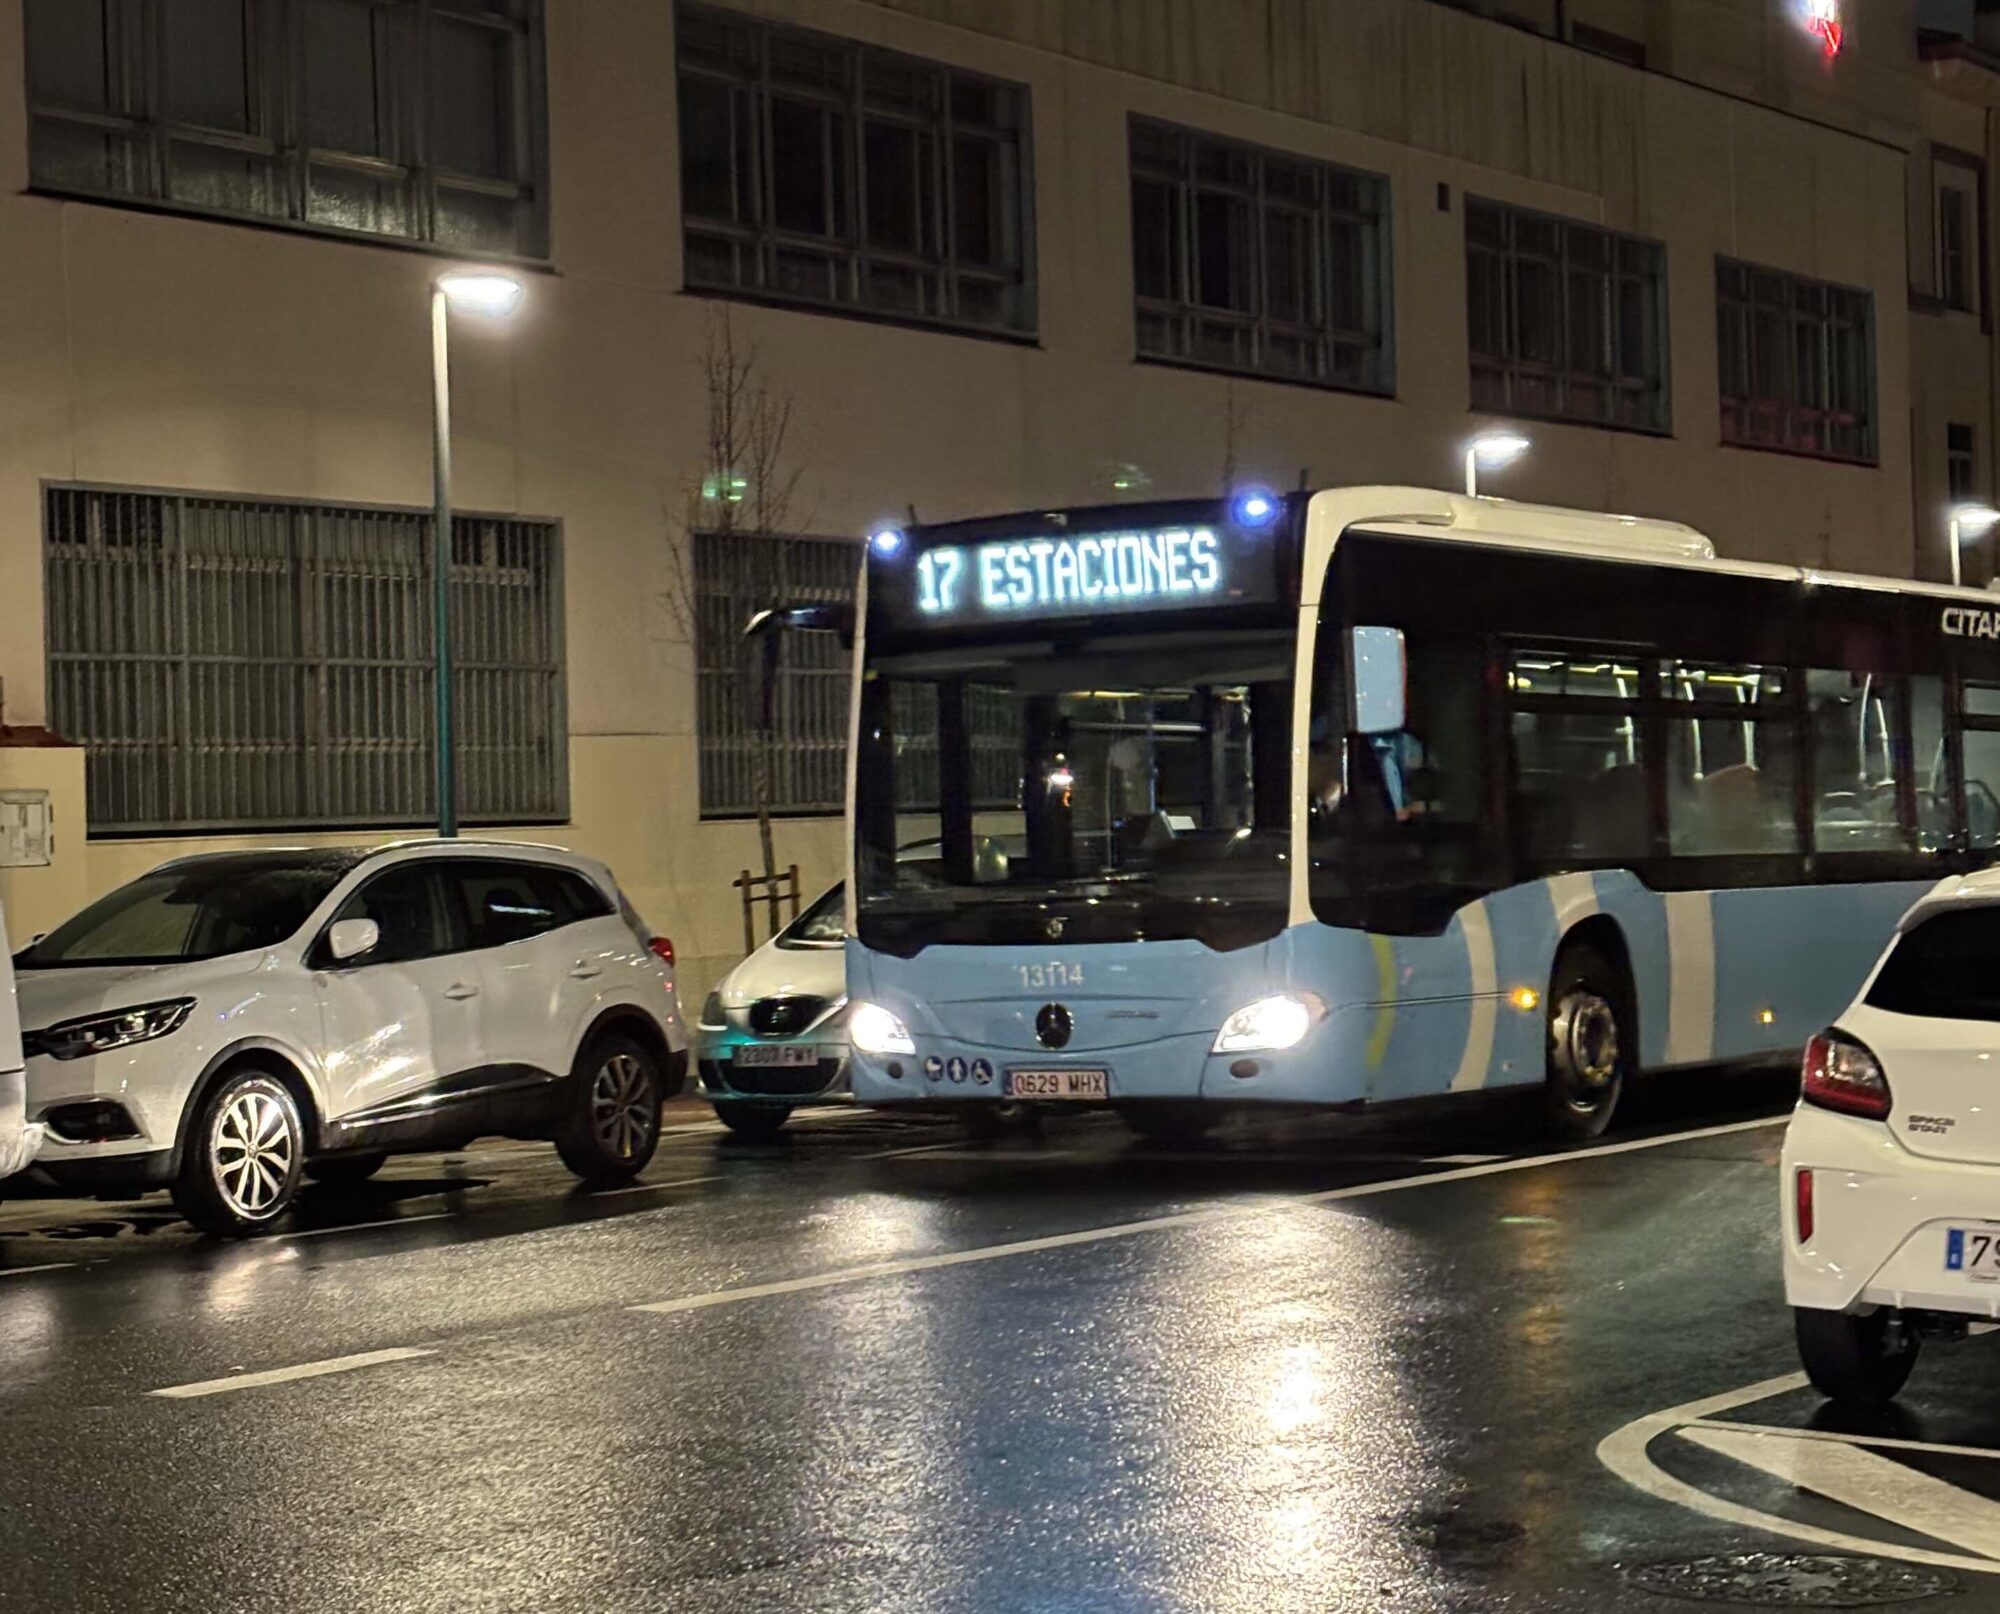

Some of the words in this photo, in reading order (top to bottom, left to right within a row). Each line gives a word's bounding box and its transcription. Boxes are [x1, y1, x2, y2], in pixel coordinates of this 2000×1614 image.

[916, 546, 960, 613] 17
[979, 528, 1220, 608] ESTACIONES
[1019, 964, 1083, 988] 13114
[1015, 1074, 1059, 1093] 0629
